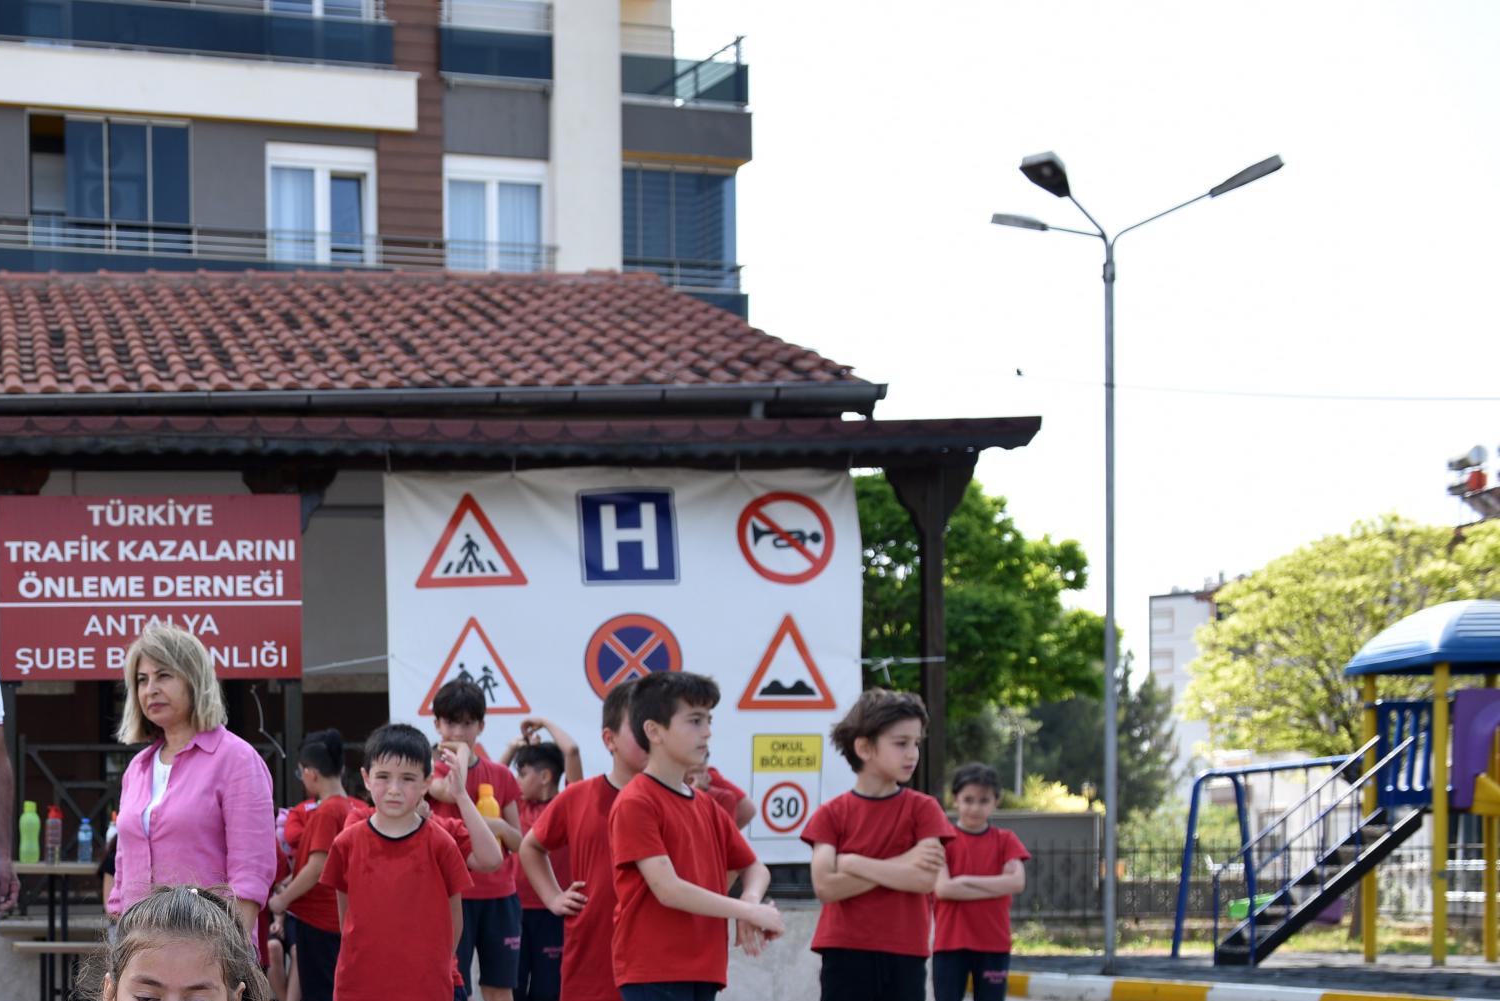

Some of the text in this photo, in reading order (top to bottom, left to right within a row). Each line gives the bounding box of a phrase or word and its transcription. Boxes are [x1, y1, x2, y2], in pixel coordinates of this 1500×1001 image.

[87, 499, 214, 526] TÜRKİYE
[4, 535, 296, 563] TRAFİK KAZALARINI
[600, 502, 659, 572] H
[18, 569, 284, 598] ÖNLEME DERNEĞİ
[15, 640, 288, 675] ŞUBE BNLIĞI
[771, 741, 805, 752] OKUL
[760, 753, 816, 768] BÖLGESİ
[771, 796, 799, 819] 30
